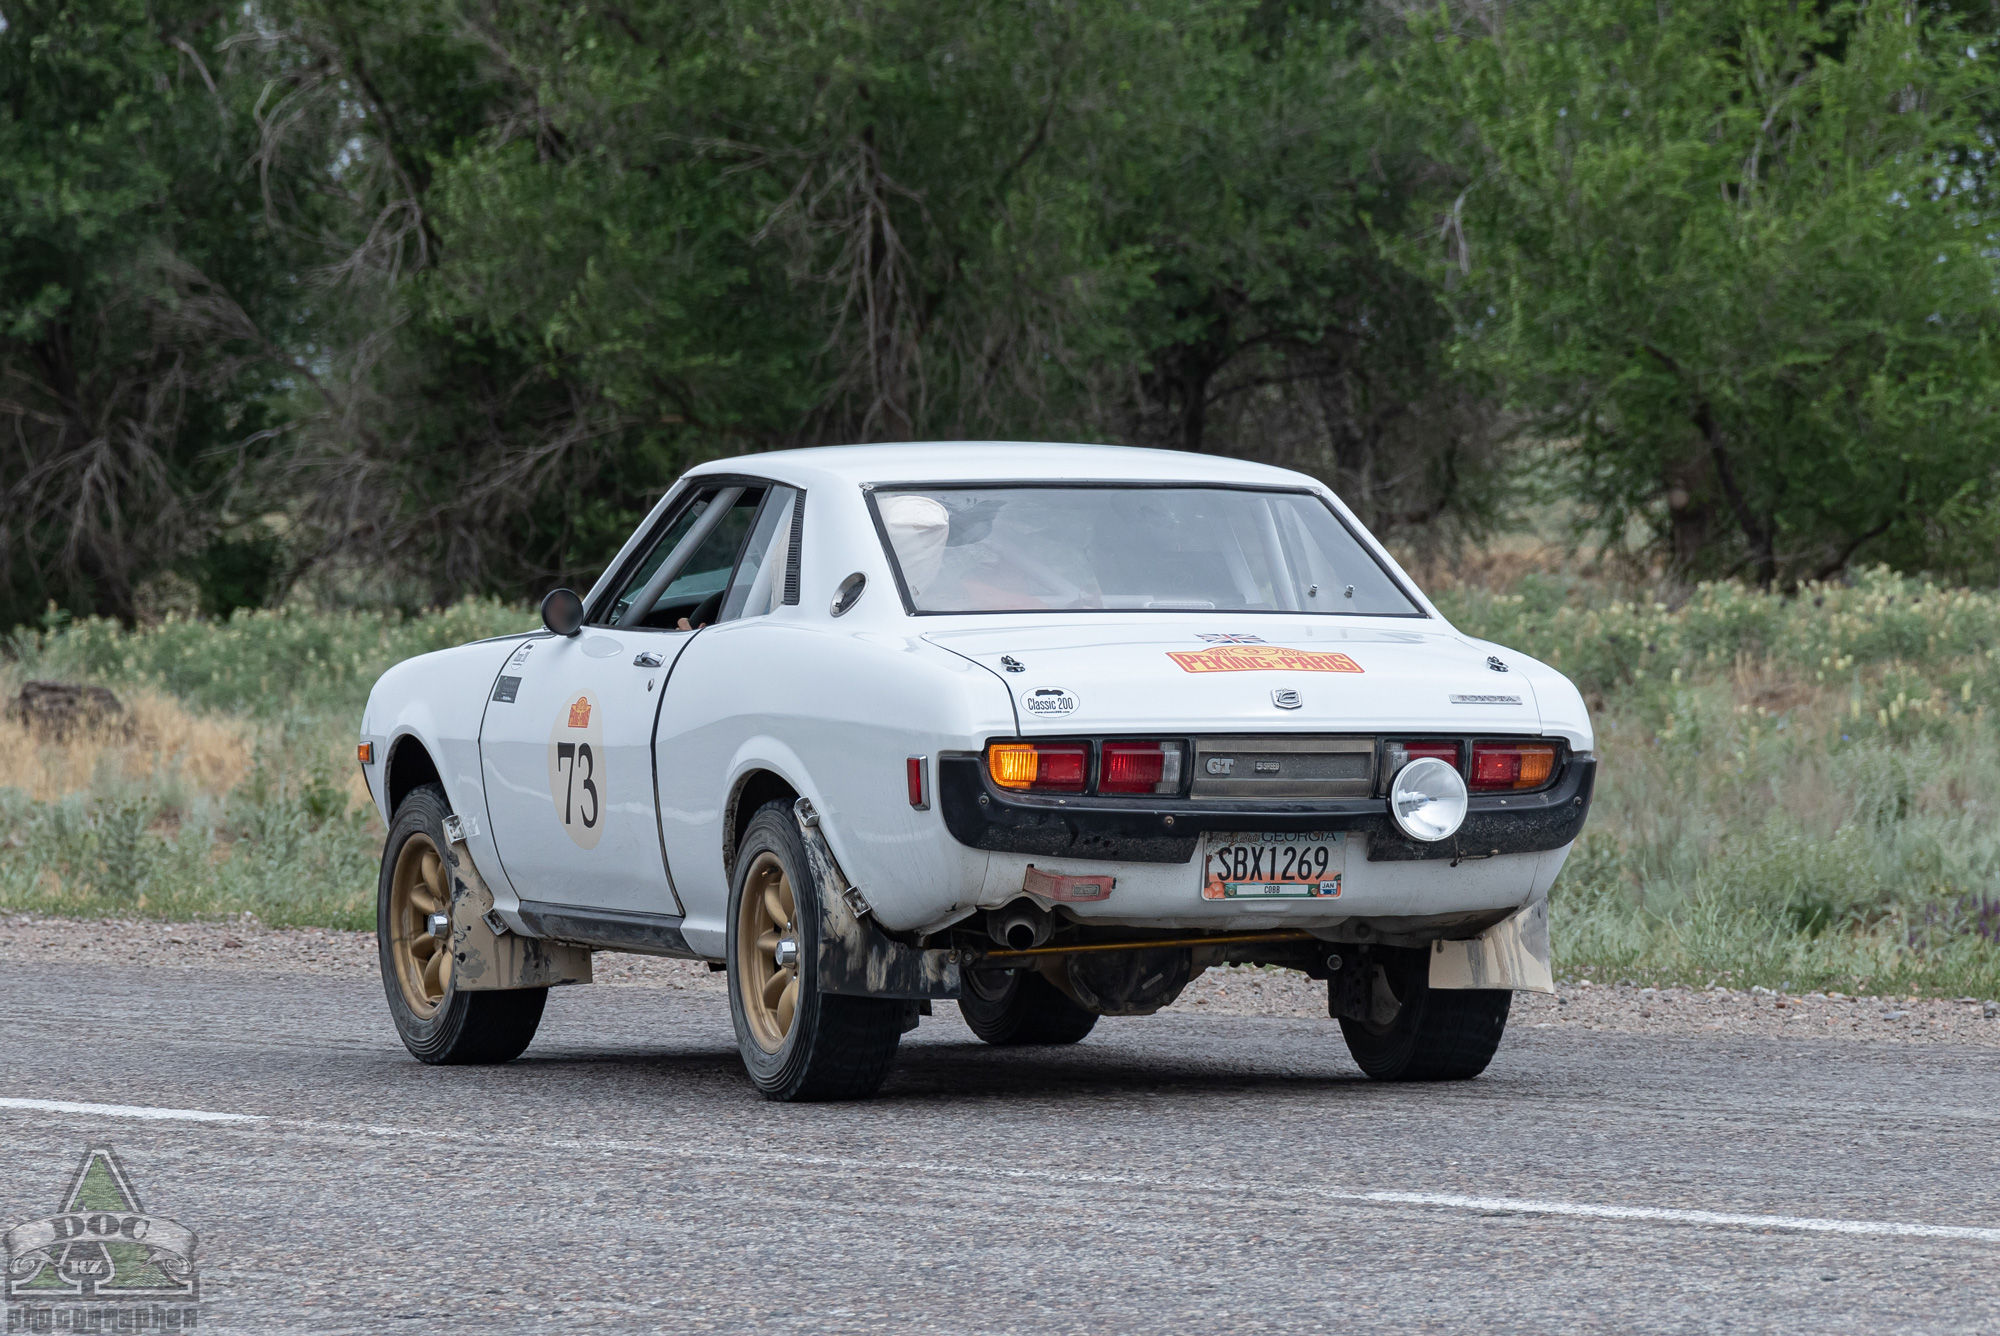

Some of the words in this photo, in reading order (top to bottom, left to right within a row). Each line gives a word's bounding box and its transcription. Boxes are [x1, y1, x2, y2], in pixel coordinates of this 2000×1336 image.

[1180, 654, 1274, 670] PEKING
[1276, 654, 1358, 671] PARIS
[1027, 697, 1057, 710] Classic
[1057, 697, 1074, 710] 200
[1206, 757, 1234, 775] GT
[1255, 762, 1263, 770] 5
[557, 742, 599, 828] 73
[1261, 832, 1337, 842] GEORGIA
[1216, 846, 1329, 881] SBX1269
[1264, 885, 1281, 894] COBB
